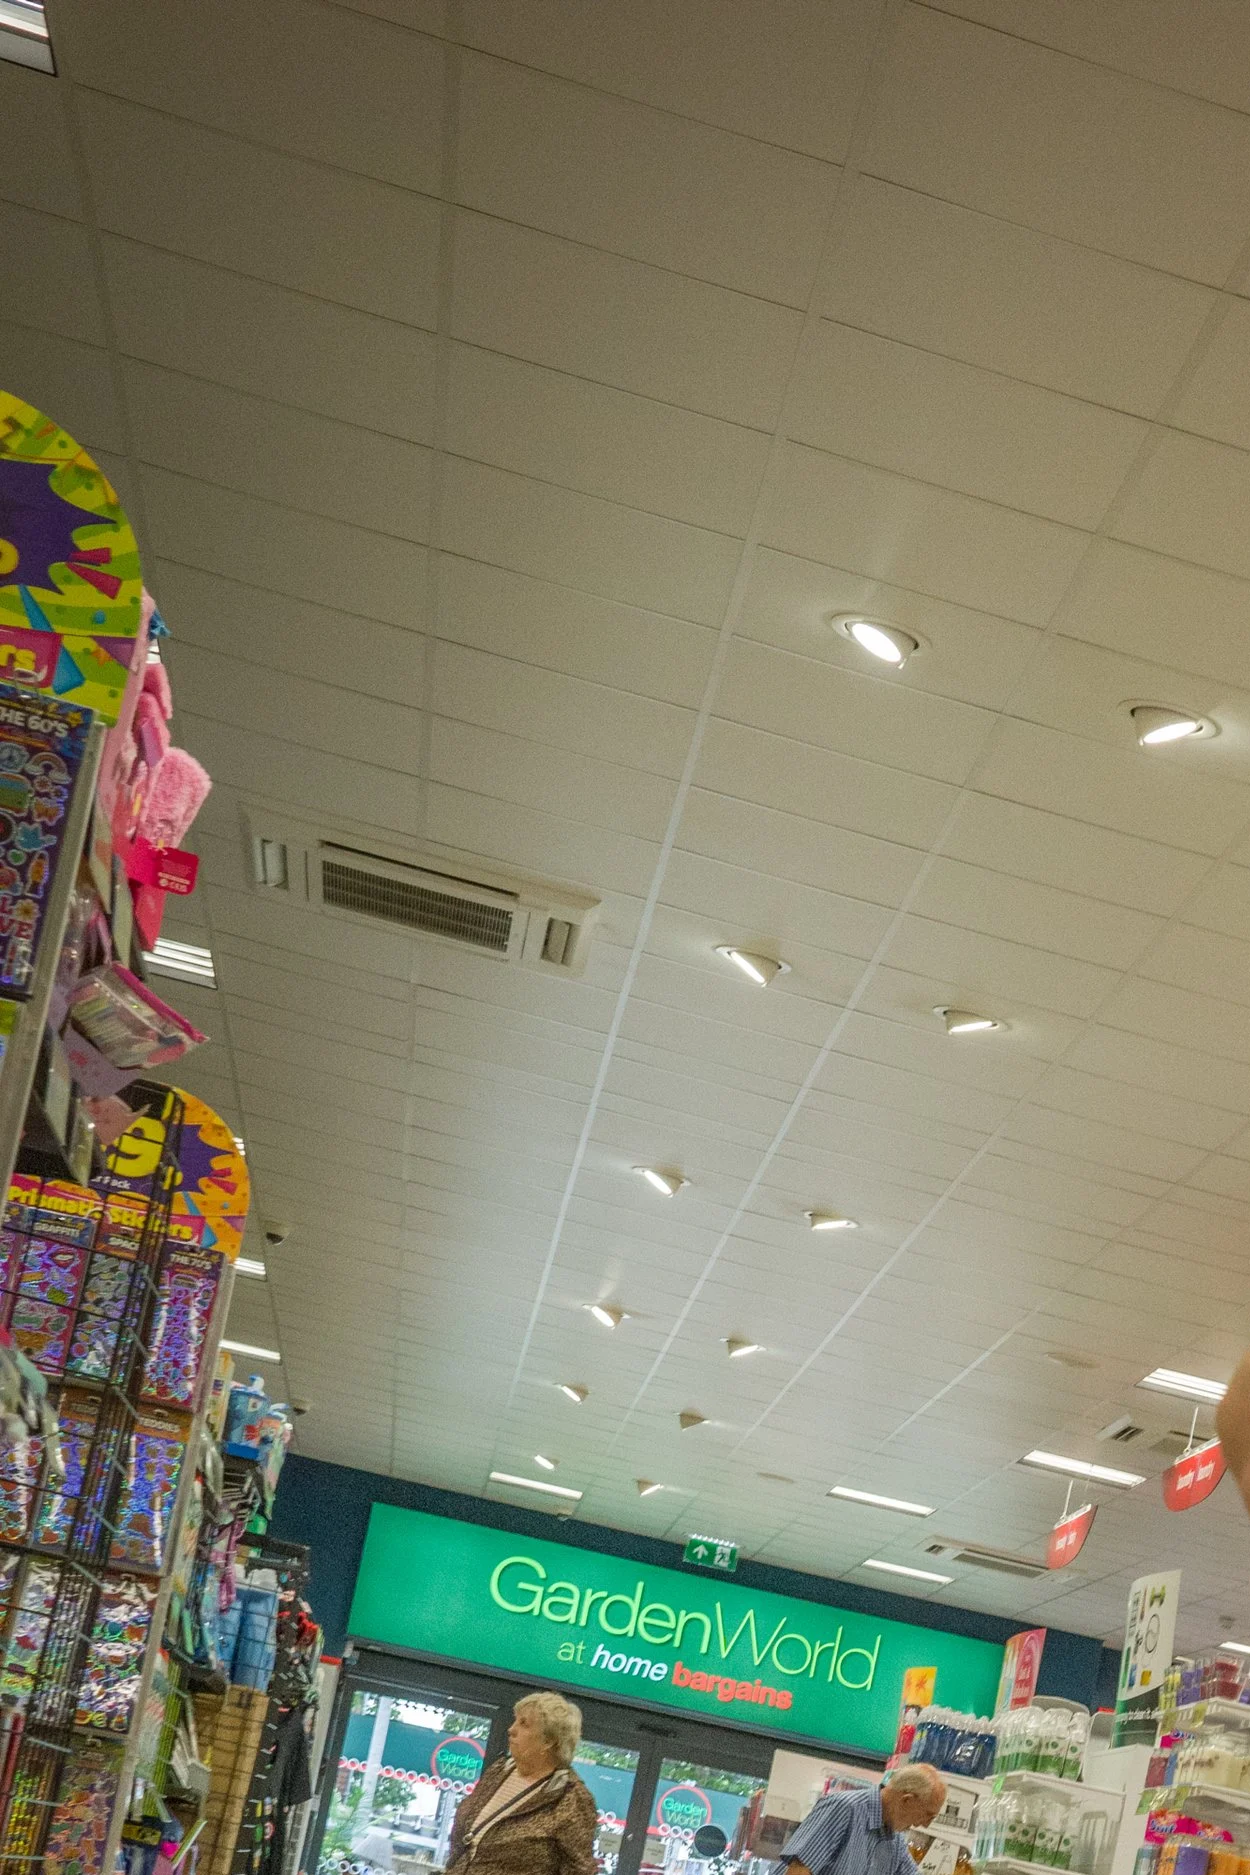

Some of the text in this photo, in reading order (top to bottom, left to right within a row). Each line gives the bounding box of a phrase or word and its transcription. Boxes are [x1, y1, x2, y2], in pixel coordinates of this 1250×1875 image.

[556, 1638, 794, 1711] at home bargains
[435, 1748, 484, 1770] Garden
[440, 1760, 477, 1780] World
[662, 1795, 709, 1817] Garden
